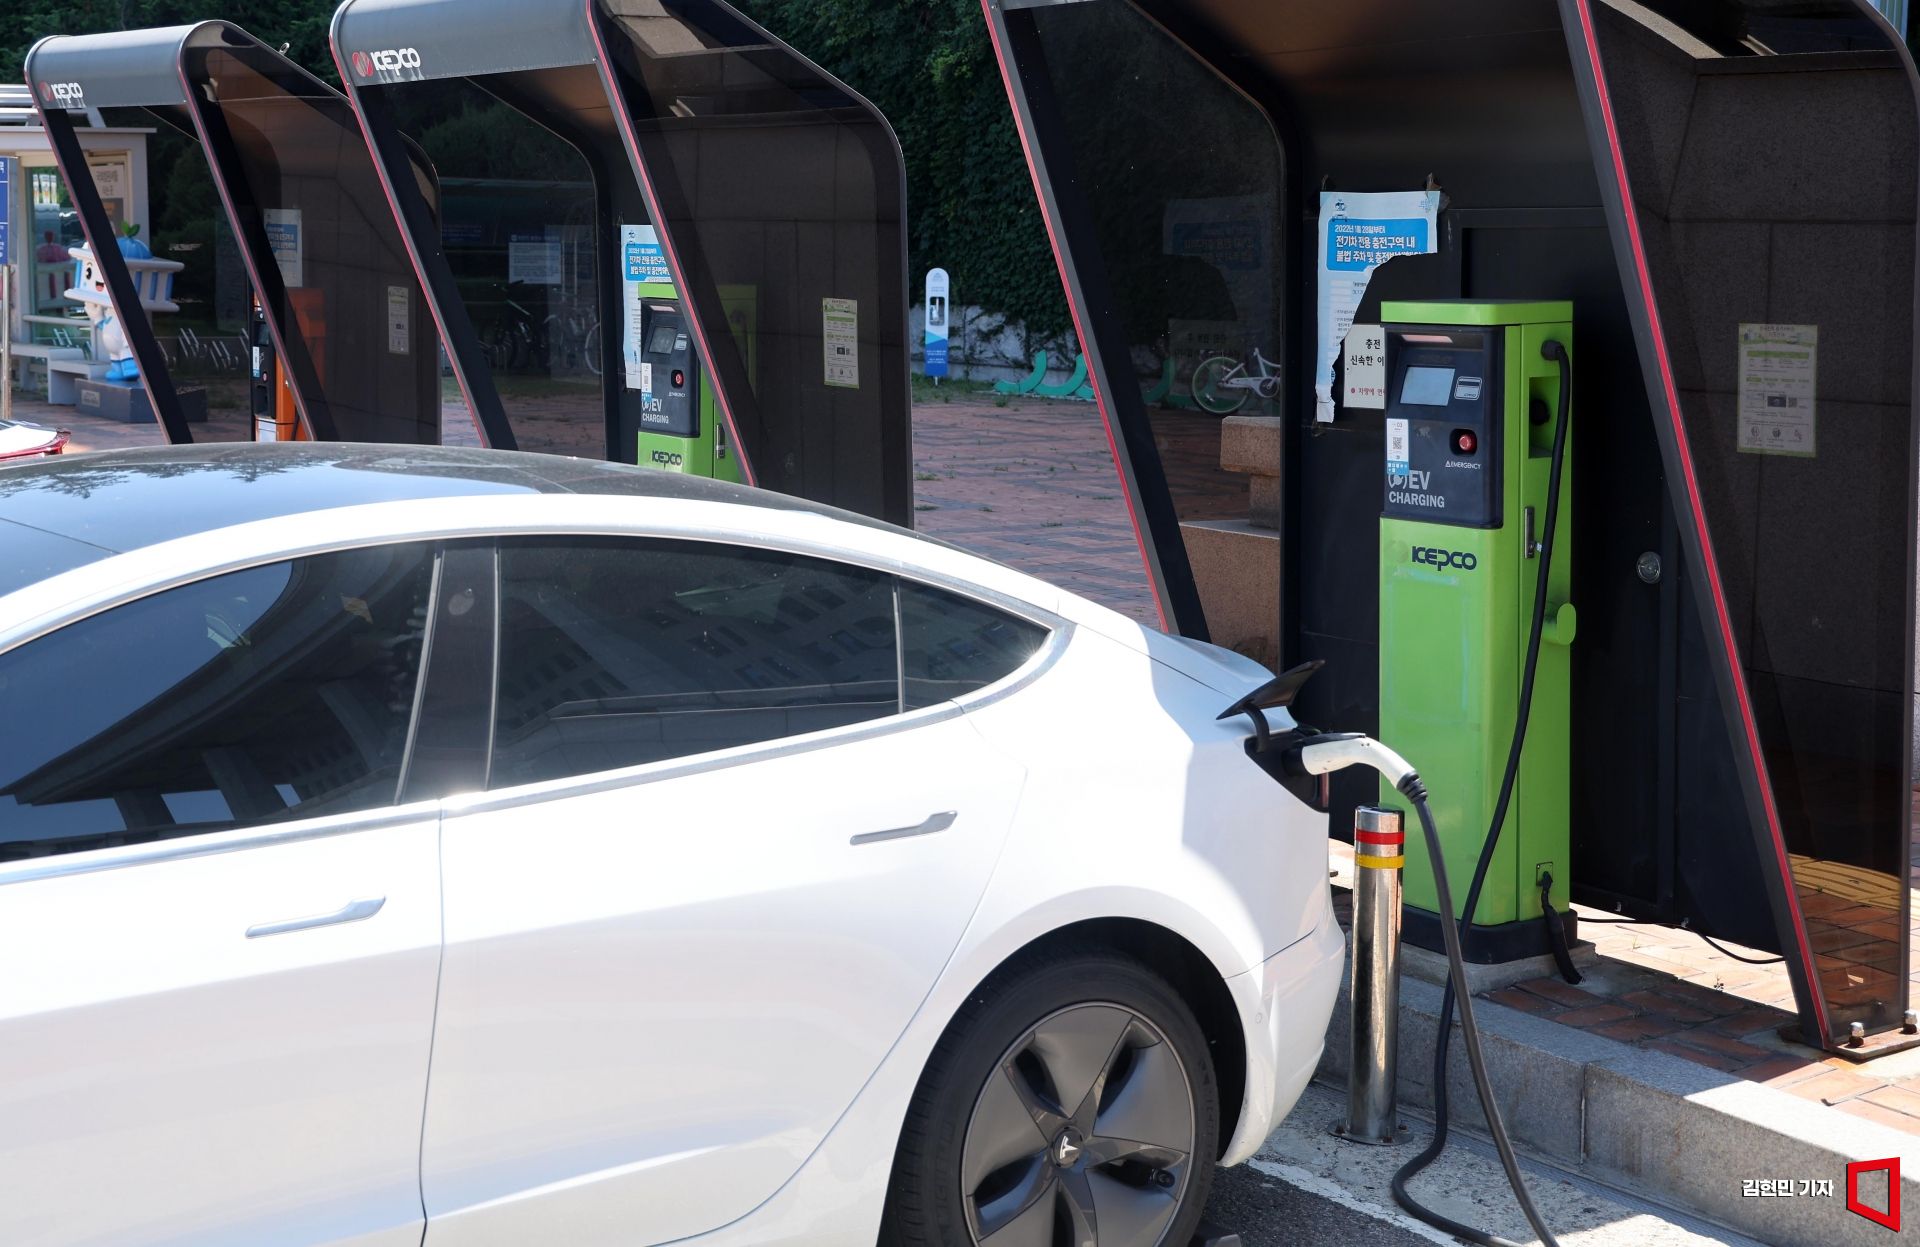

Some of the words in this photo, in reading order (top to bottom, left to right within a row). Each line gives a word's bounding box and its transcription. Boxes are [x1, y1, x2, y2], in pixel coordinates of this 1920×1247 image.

[370, 48, 421, 76] KEPCO
[51, 82, 84, 103] KEPCO
[1335, 224, 1354, 233] 2022년
[1336, 235, 1357, 248] 전기차
[1358, 236, 1371, 249] 전용
[1372, 236, 1404, 249] 충전구역
[1406, 236, 1416, 249] 내
[1336, 250, 1351, 263] 불법
[1353, 251, 1366, 263] 주차
[1366, 251, 1375, 264] 및
[1366, 339, 1381, 350] 충전
[1351, 355, 1373, 366] 신속한
[642, 412, 669, 424] CHARGING
[652, 449, 682, 470] KEPCO
[1451, 461, 1481, 470] EMERGENCY
[1408, 469, 1431, 491] EV
[1388, 491, 1445, 508] CHARGING
[1411, 545, 1478, 572] KEPCO
